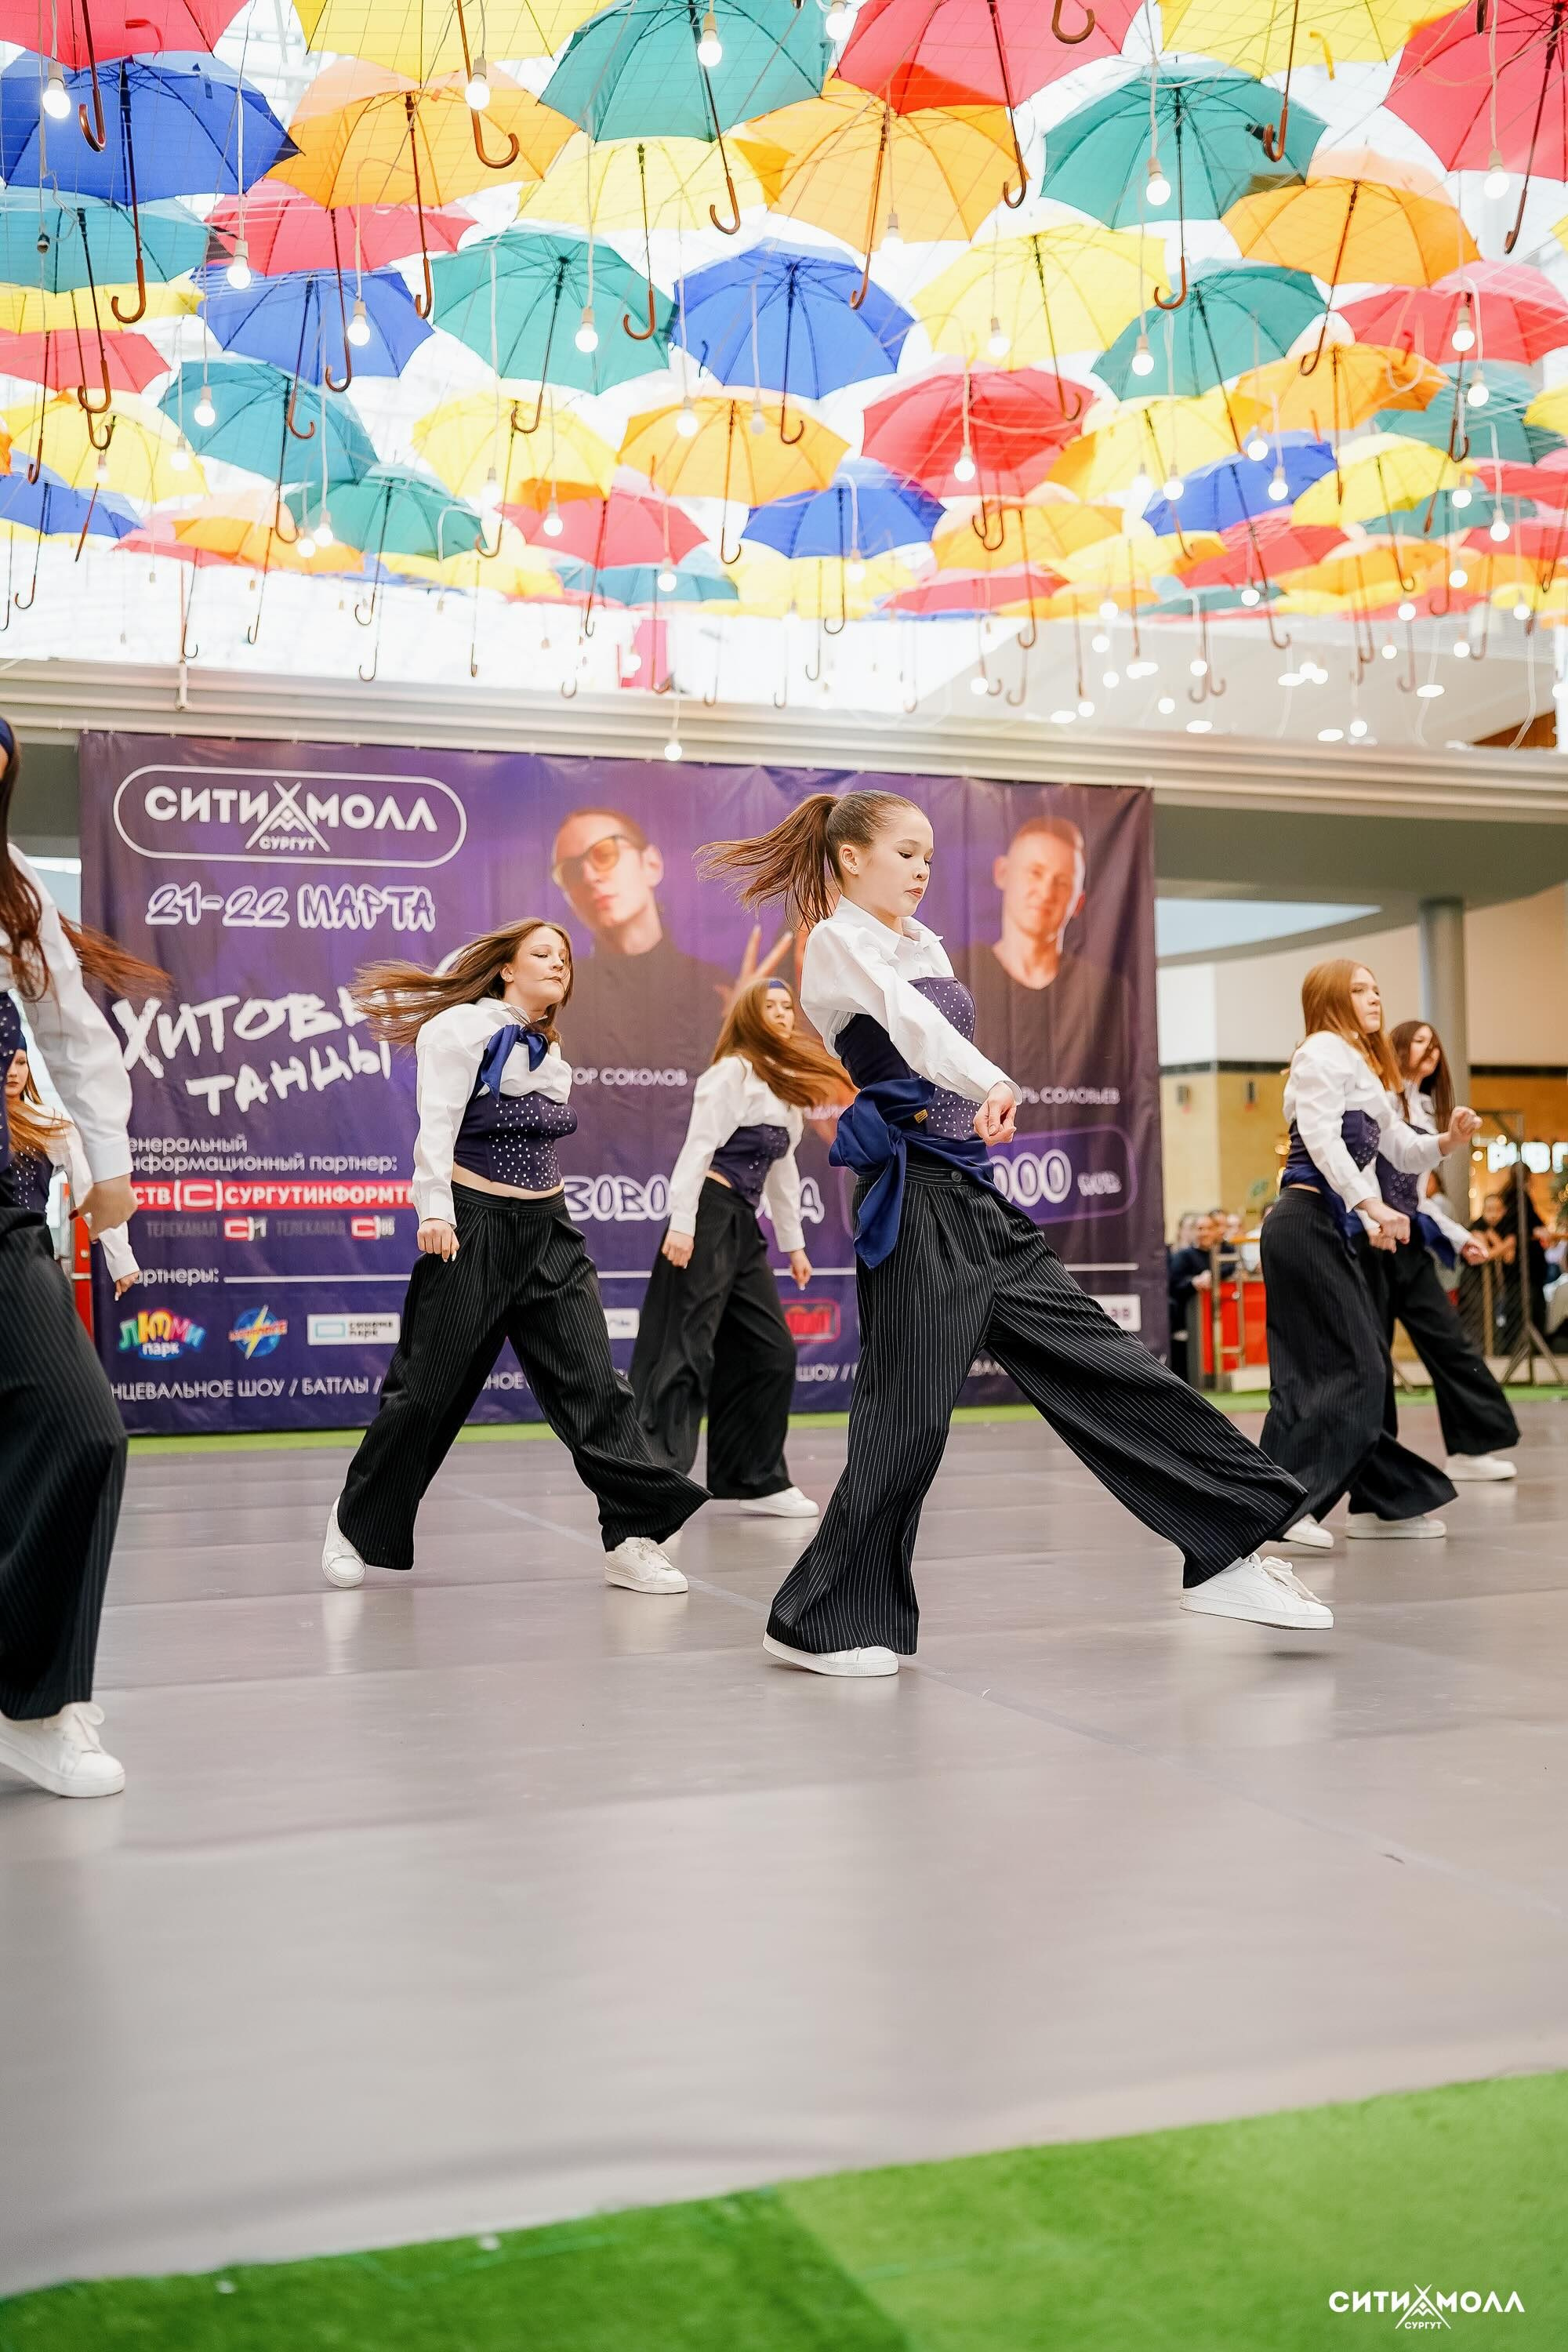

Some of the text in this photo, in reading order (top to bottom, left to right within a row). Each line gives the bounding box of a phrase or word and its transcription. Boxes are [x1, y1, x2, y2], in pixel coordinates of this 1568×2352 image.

[144, 785, 439, 833] СИТИ МОЛЛ
[259, 834, 317, 851] СУРГУТ
[145, 880, 437, 932] 21-22 МАРТА
[185, 1033, 391, 1116] ТАНЦЫ
[600, 1067, 688, 1087] СОКОЛОВ
[129, 1133, 248, 1156] енеральный
[132, 1152, 397, 1175] нформационный партнер:
[135, 1267, 219, 1287] артнеры:
[142, 1341, 180, 1358] парк
[238, 1377, 285, 1398] ШОУ
[302, 1375, 369, 1396] БАТТЛЫ
